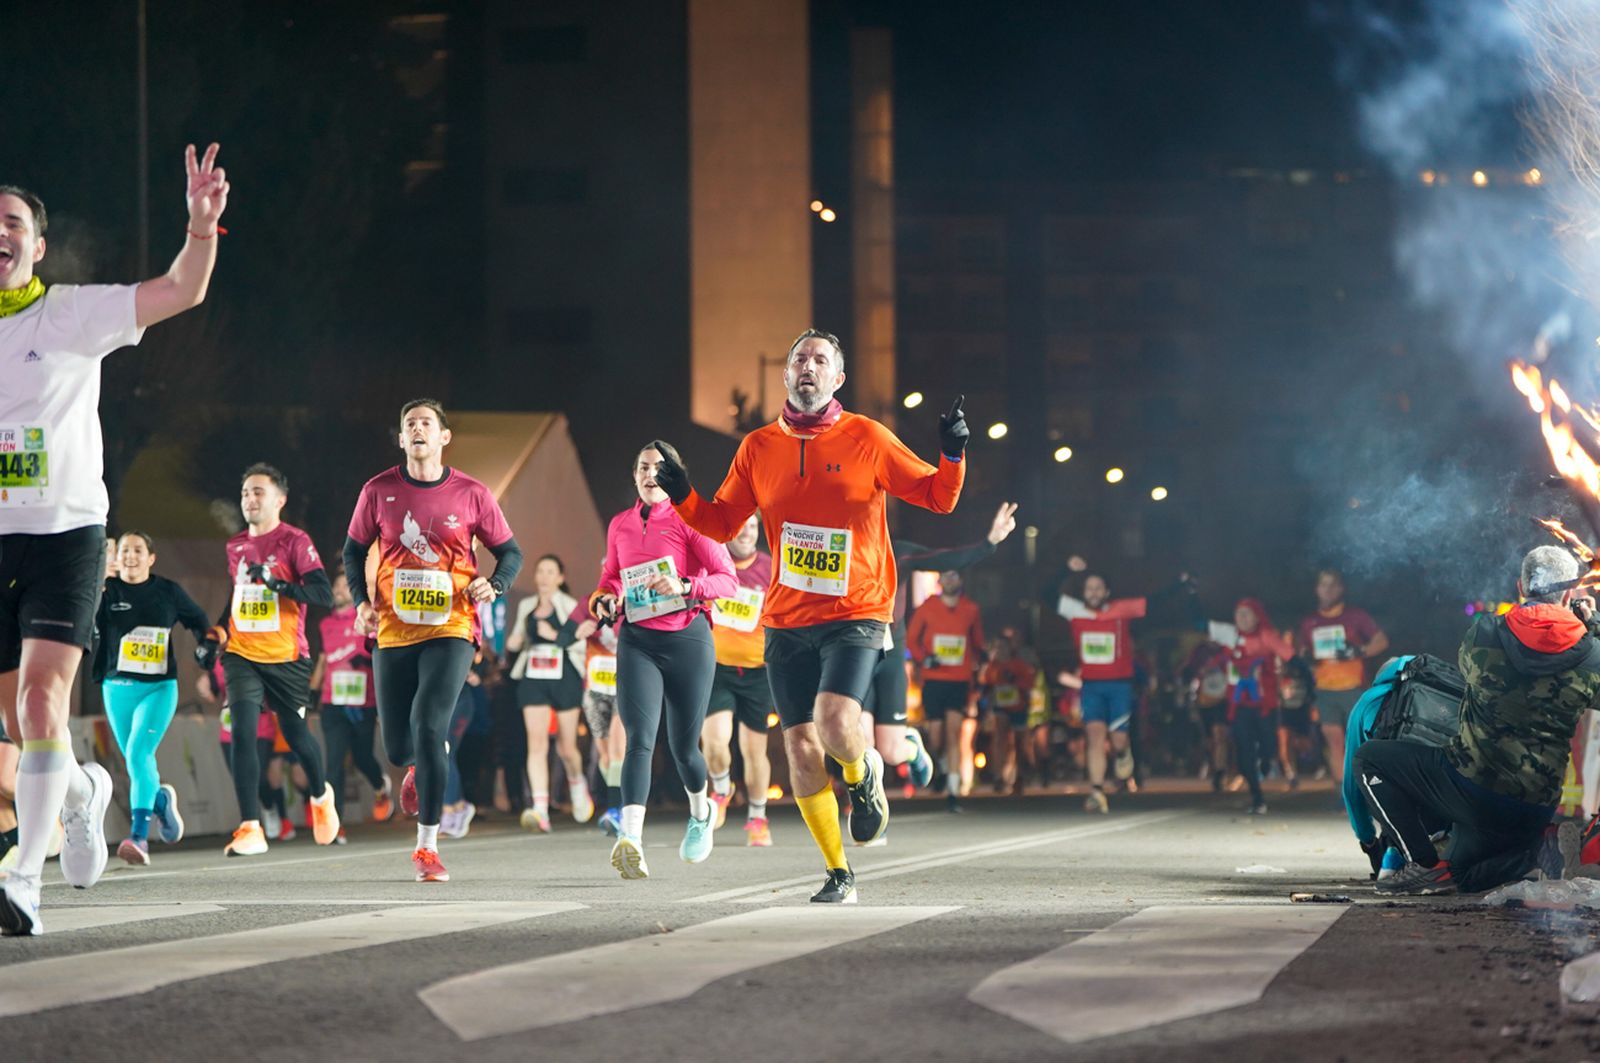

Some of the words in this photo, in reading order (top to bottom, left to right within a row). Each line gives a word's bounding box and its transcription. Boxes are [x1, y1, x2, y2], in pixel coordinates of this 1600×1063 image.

[5, 432, 15, 440] DE
[793, 532, 815, 540] NOCHE
[412, 540, 426, 554] 43
[787, 547, 840, 572] 12483
[400, 589, 445, 607] 12456
[131, 643, 159, 658] 3481
